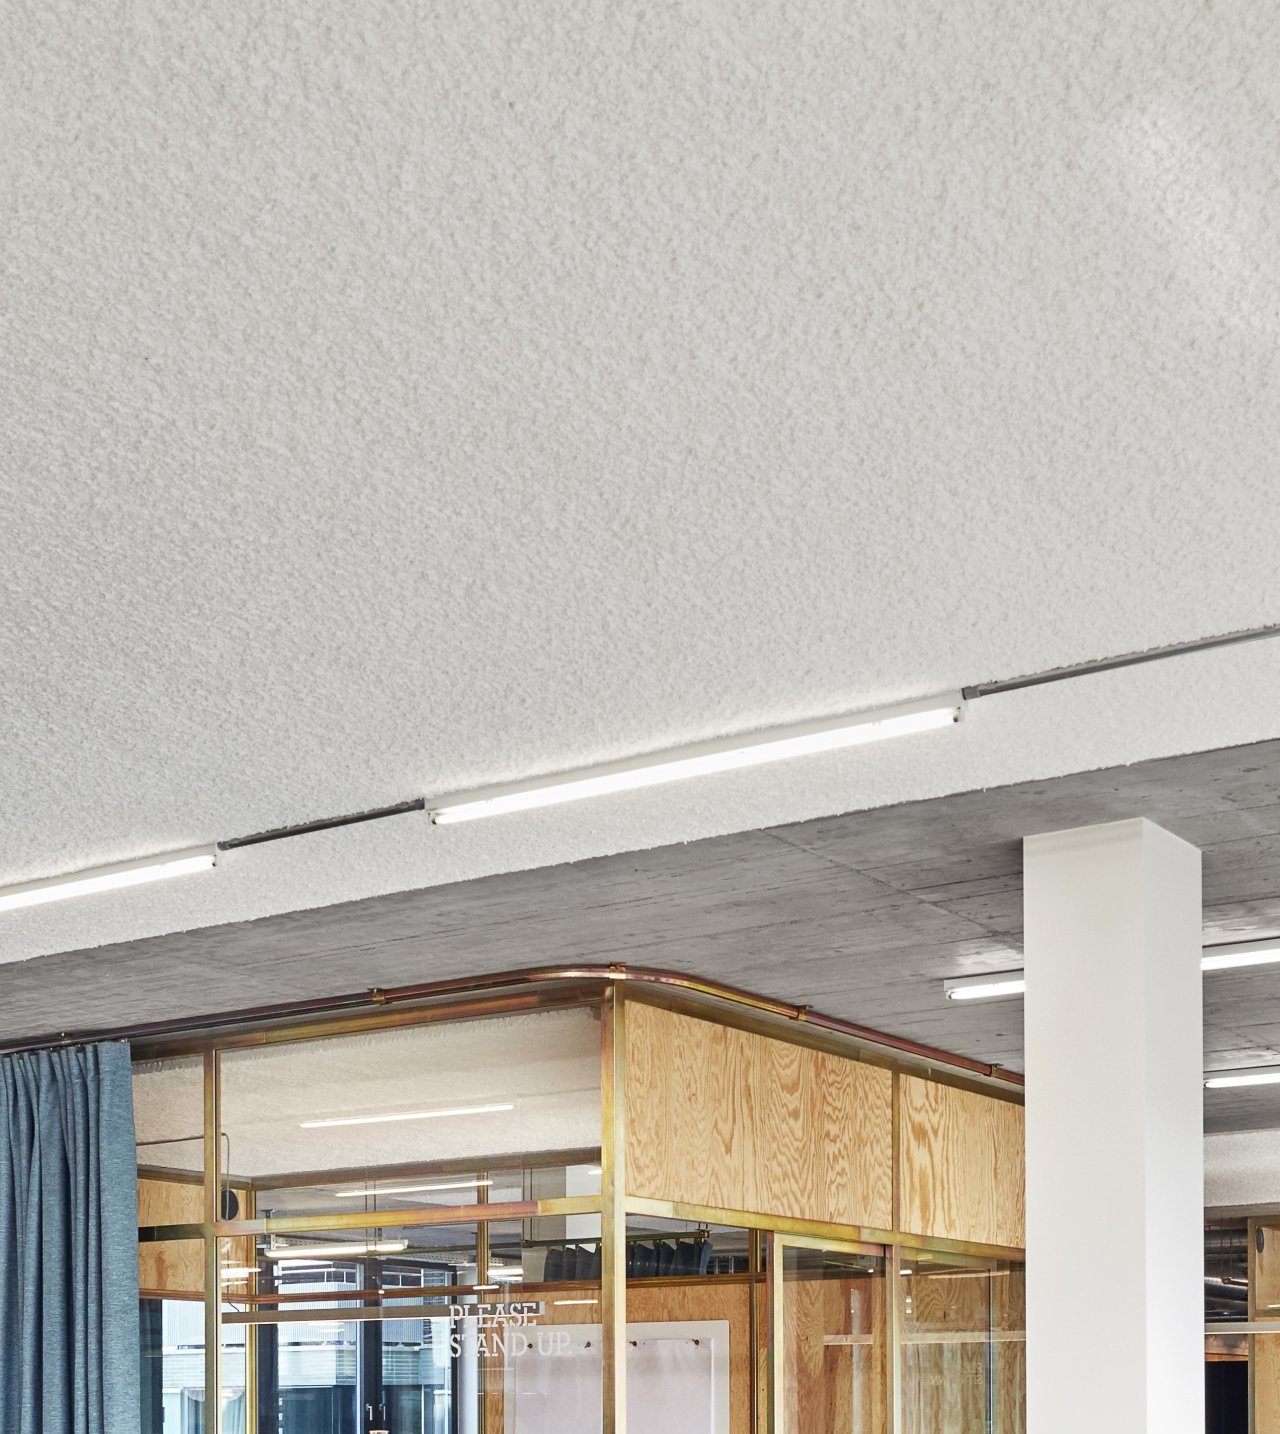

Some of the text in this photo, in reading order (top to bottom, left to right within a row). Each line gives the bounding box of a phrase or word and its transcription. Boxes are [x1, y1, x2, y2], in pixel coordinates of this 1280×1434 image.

[449, 1302, 537, 1329] PLEASE
[450, 1331, 573, 1357] SAND UP.
